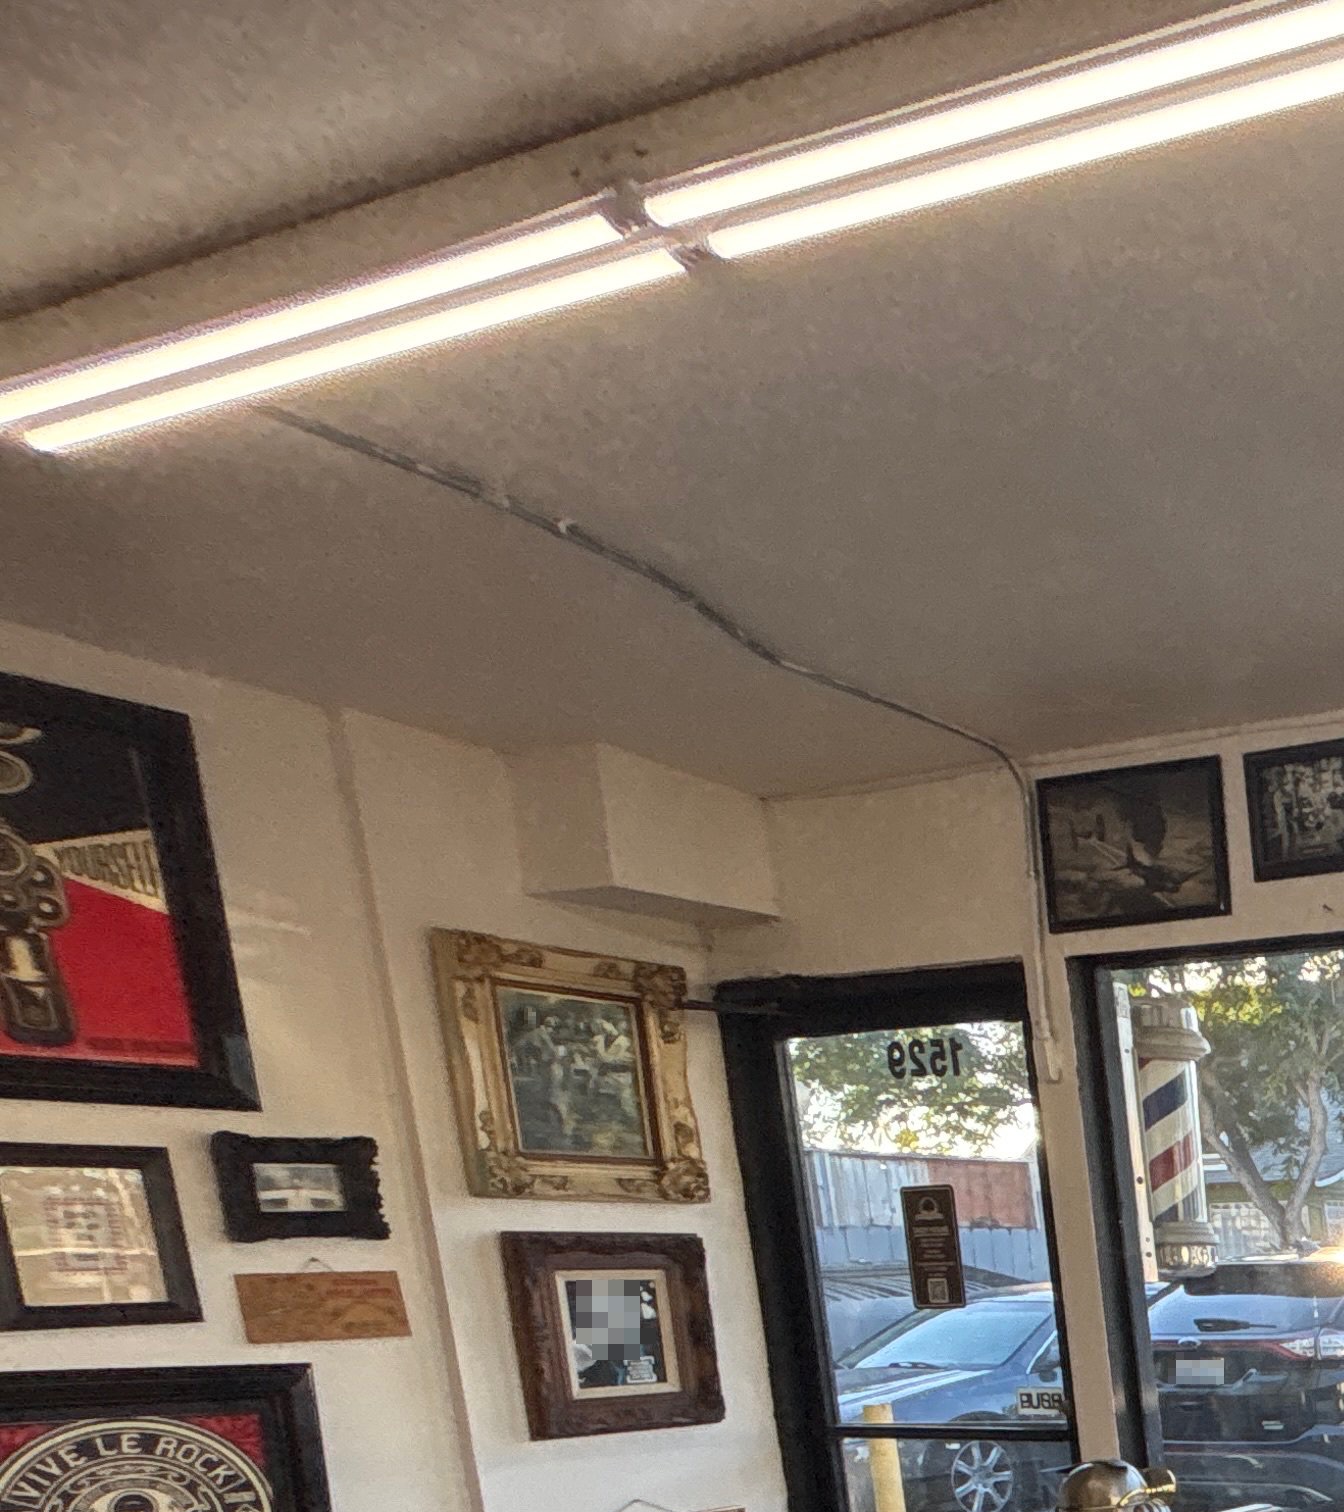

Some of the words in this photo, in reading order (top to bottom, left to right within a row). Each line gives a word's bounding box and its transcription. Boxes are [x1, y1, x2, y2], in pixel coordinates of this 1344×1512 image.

[10, 1443, 88, 1500] VIVE
[95, 1433, 143, 1456] LE
[154, 1435, 236, 1491] ROCK
